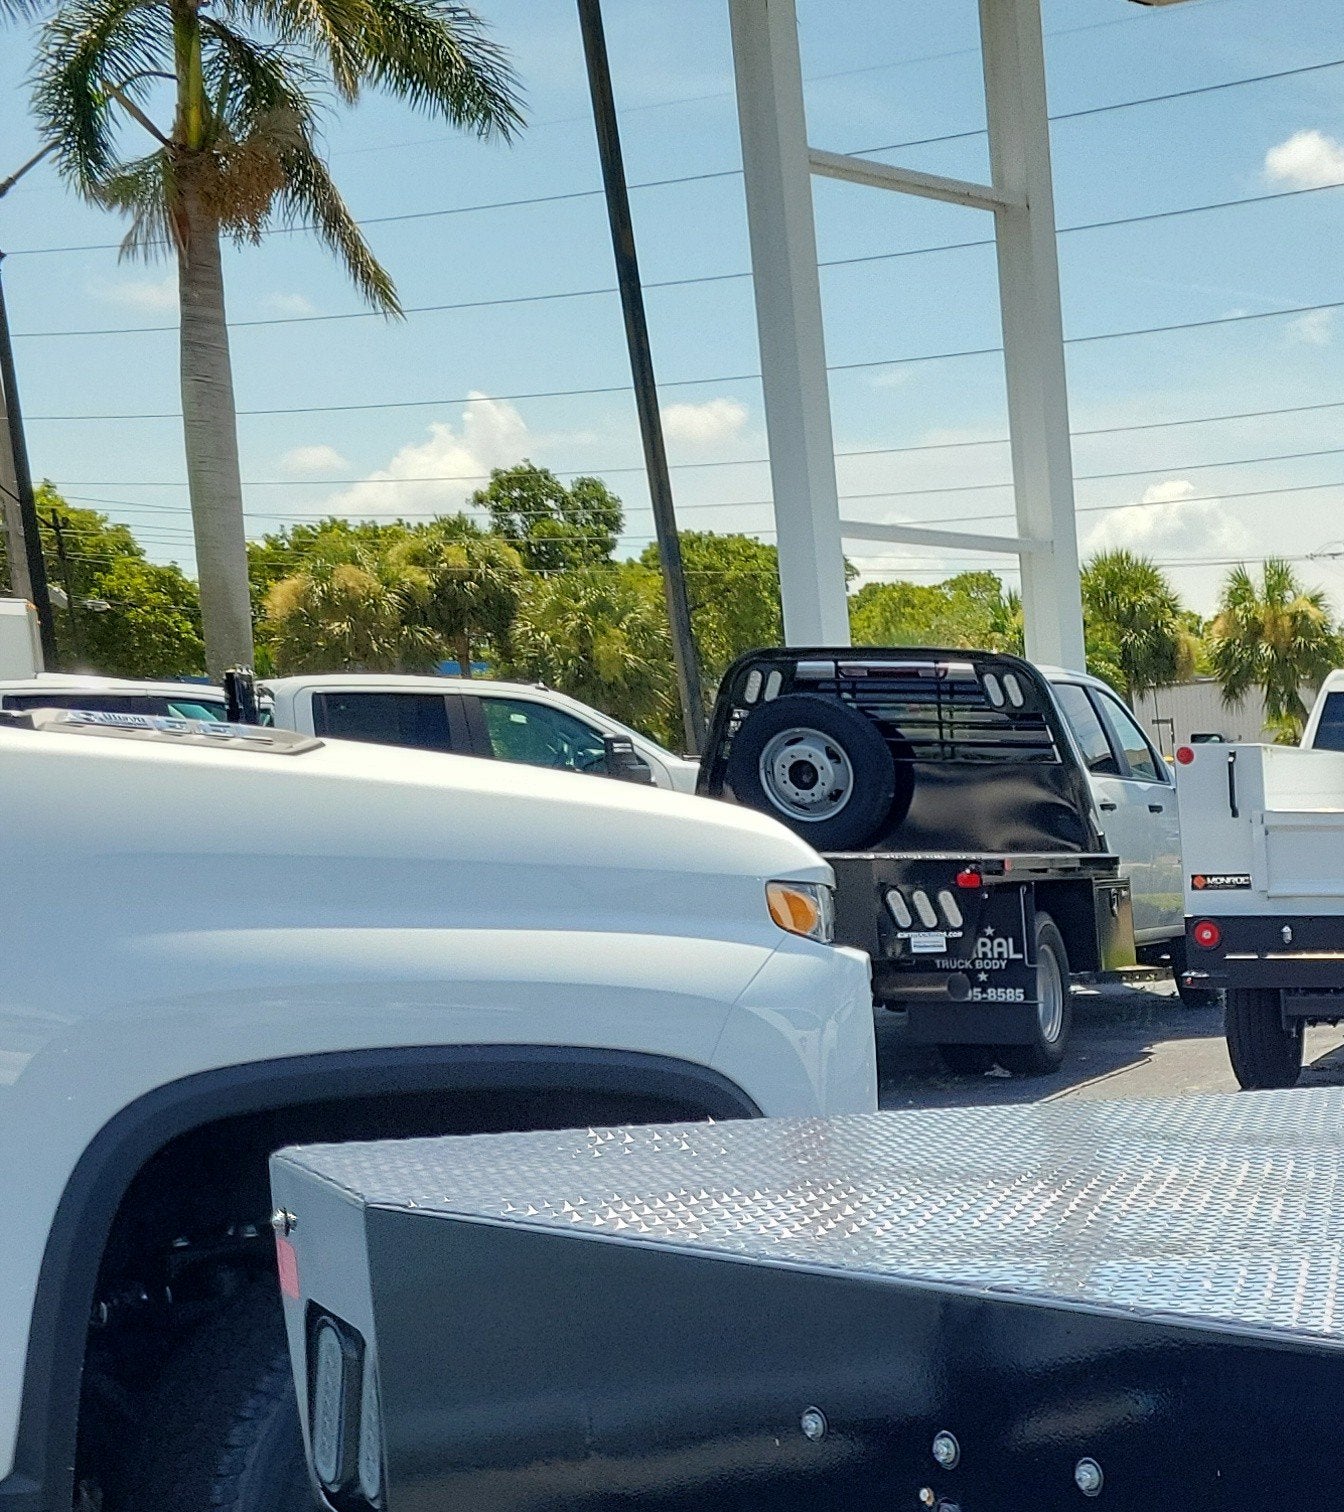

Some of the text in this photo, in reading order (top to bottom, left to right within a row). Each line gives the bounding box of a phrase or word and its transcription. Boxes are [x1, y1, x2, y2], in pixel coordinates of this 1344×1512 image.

[975, 937, 1023, 959] RAL
[935, 960, 1008, 970] TRUCK BODY
